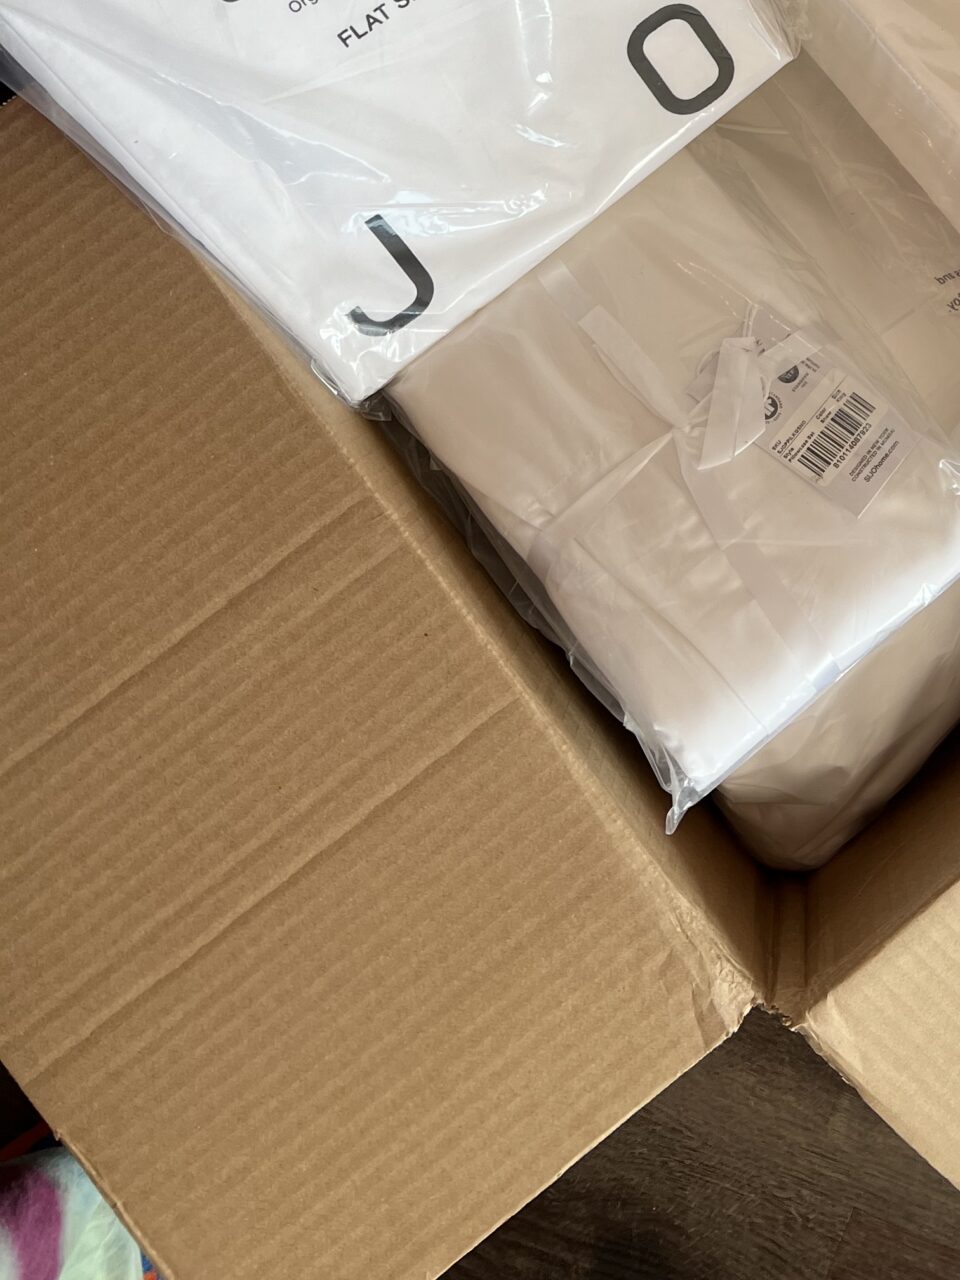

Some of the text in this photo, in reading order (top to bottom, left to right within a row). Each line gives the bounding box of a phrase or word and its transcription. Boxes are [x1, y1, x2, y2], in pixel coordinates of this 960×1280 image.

[337, 3, 390, 48] FLAT
[627, 3, 736, 116] O
[352, 214, 434, 338] J
[864, 440, 900, 483] SIJOhome.com
